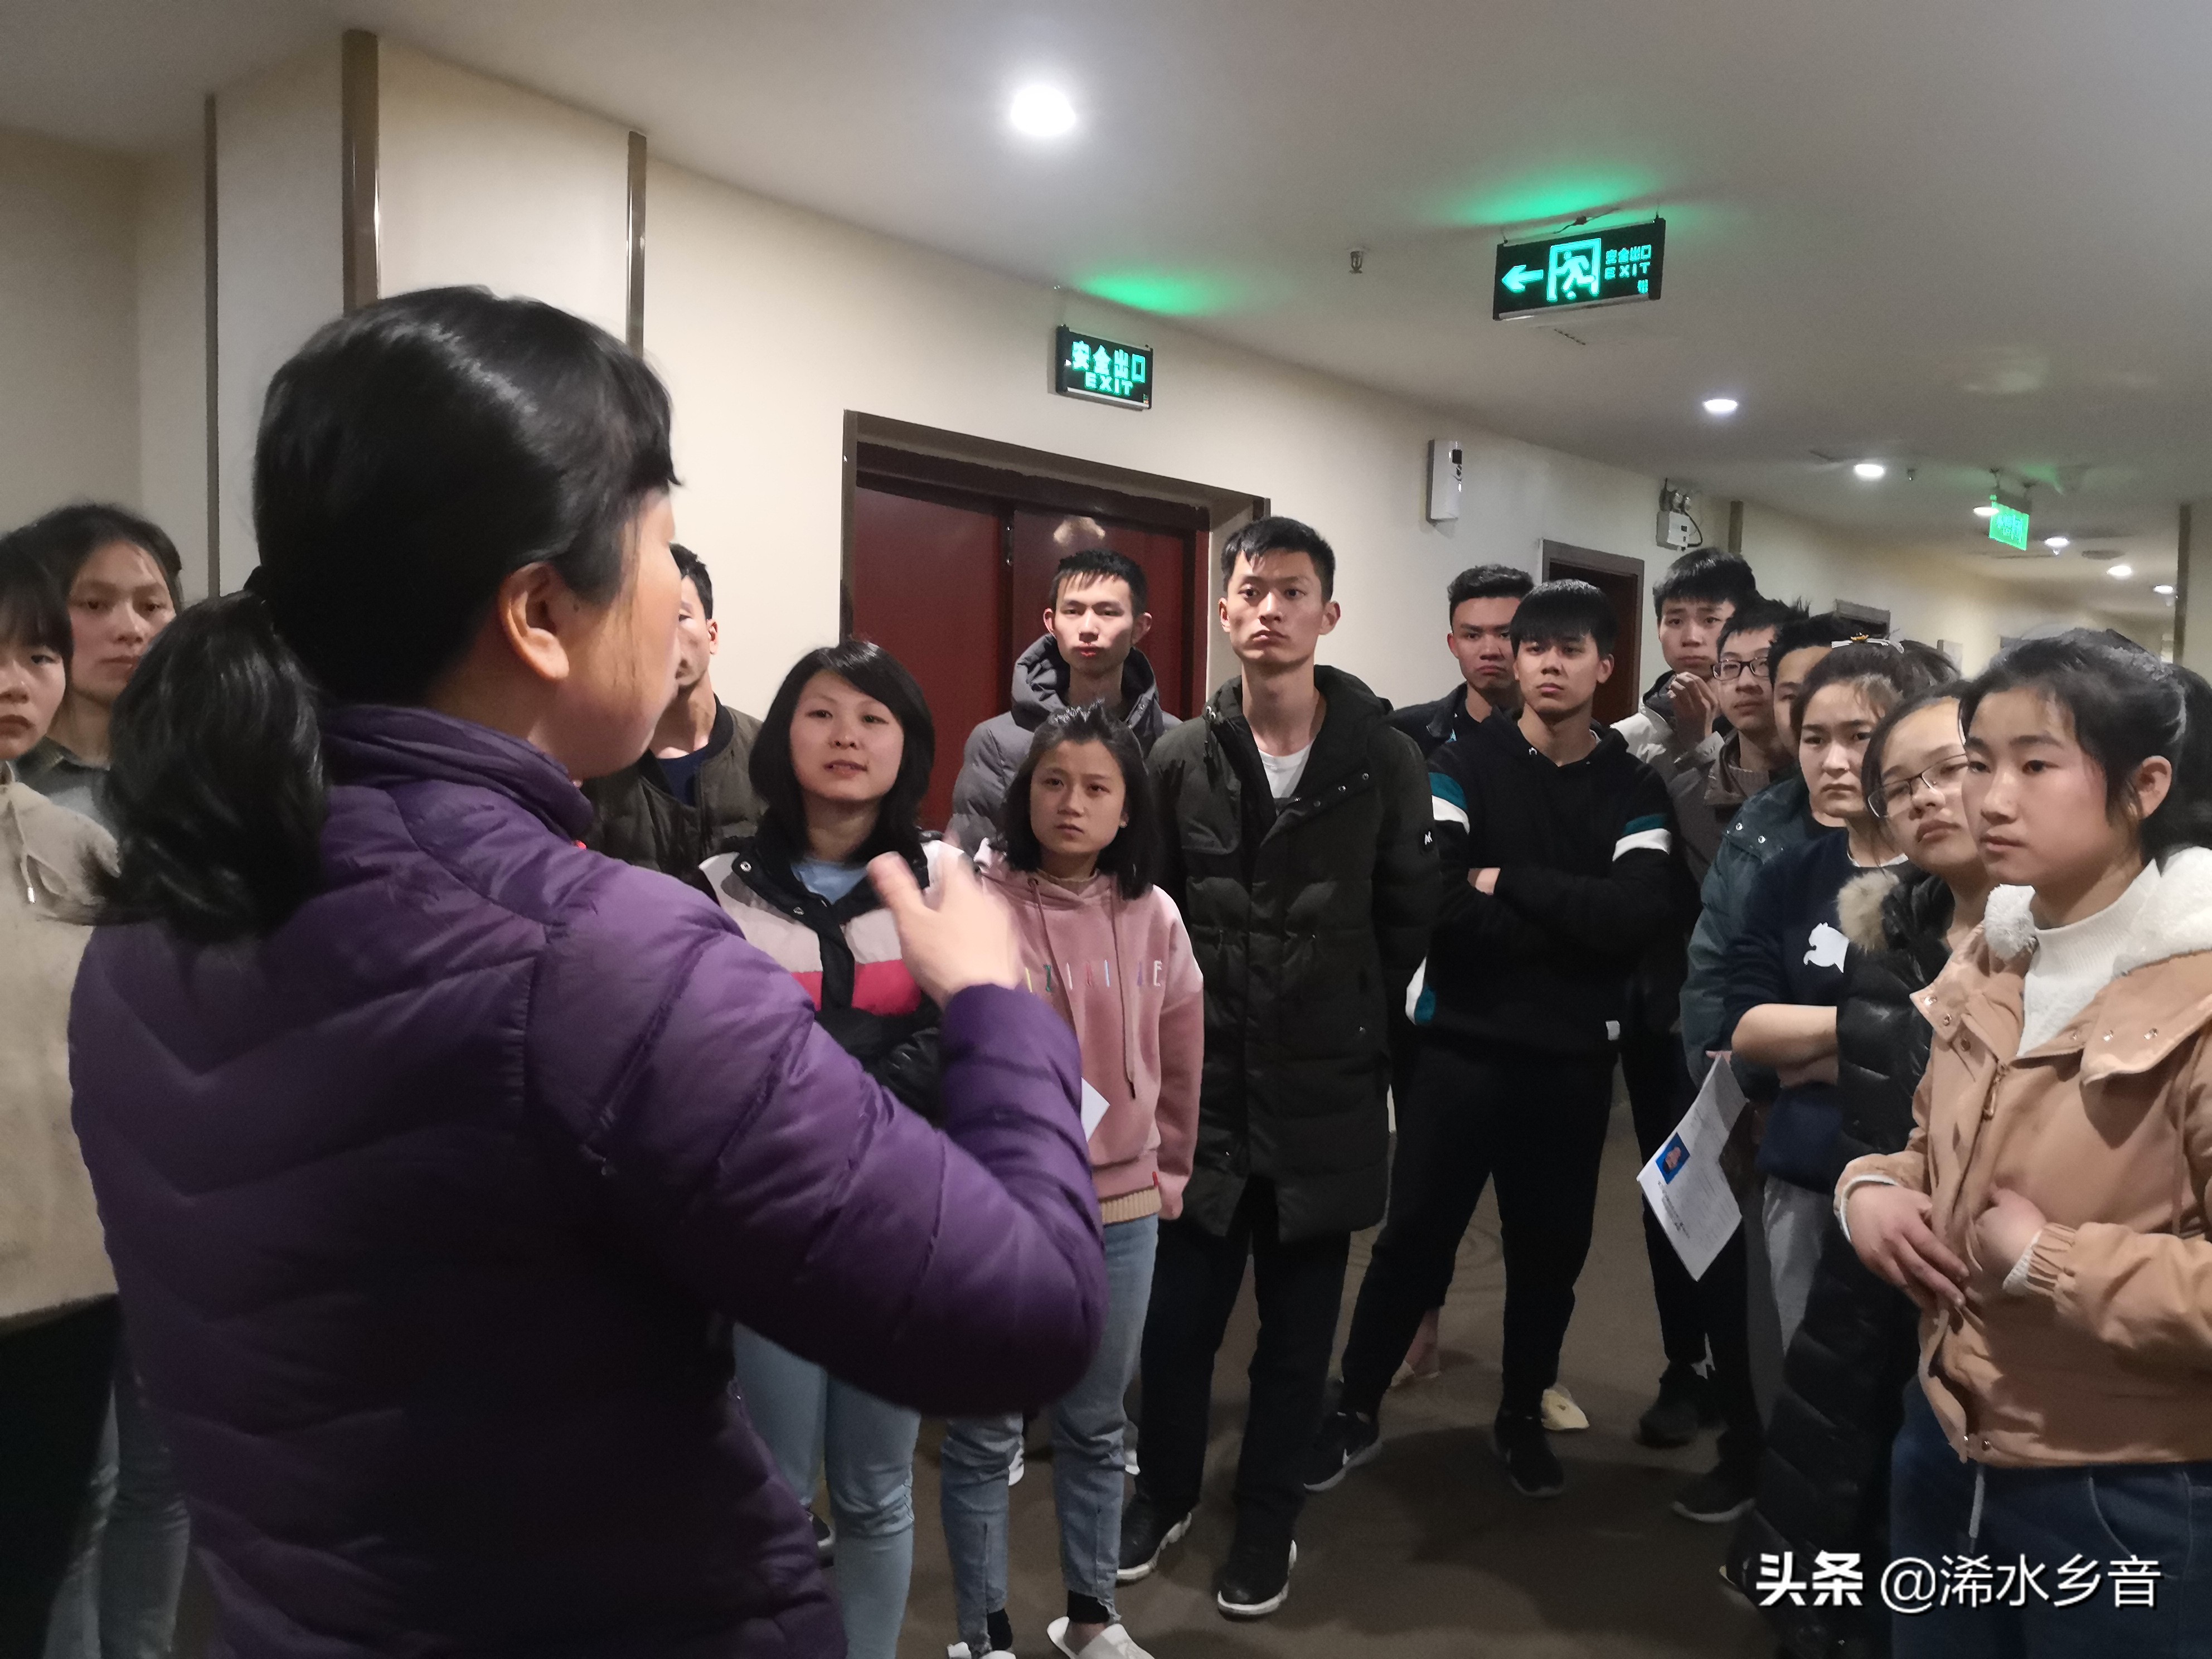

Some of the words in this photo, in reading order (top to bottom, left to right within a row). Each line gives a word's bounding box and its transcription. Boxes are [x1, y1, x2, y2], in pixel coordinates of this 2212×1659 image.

[1605, 244, 1652, 265] 安全出口
[1604, 261, 1651, 280] EXIT
[1071, 340, 1147, 384] 安全出口
[1084, 371, 1134, 396] EXIT
